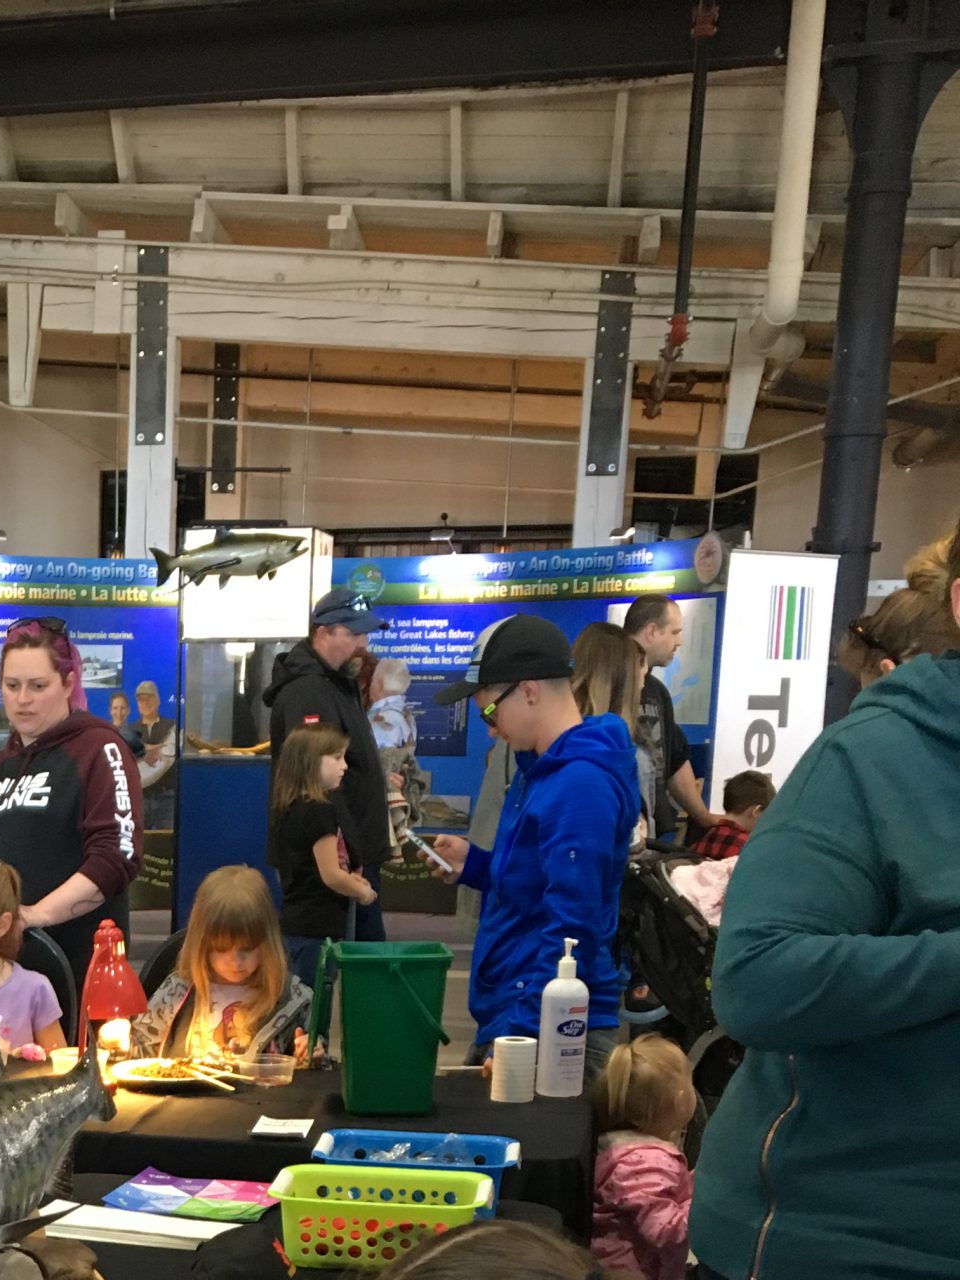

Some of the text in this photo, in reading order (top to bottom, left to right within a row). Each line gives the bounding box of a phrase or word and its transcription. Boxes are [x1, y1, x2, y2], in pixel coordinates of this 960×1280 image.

[529, 556, 547, 571] An
[550, 553, 613, 570] On-going
[616, 548, 653, 566] Battle
[46, 562, 65, 577] An
[67, 562, 135, 581] On-going
[139, 563, 158, 578] Ba
[28, 584, 76, 600] marine
[92, 586, 108, 601] La
[112, 586, 148, 602] lutte
[510, 579, 557, 596] marine
[572, 578, 589, 593] La
[592, 576, 622, 592] lutte
[384, 630, 397, 639] the
[400, 630, 422, 639] Great
[425, 629, 447, 639] Lakes
[448, 629, 475, 640] fishery.
[447, 644, 473, 654] lampro
[743, 677, 791, 770] Te
[104, 743, 131, 811] CHRIS
